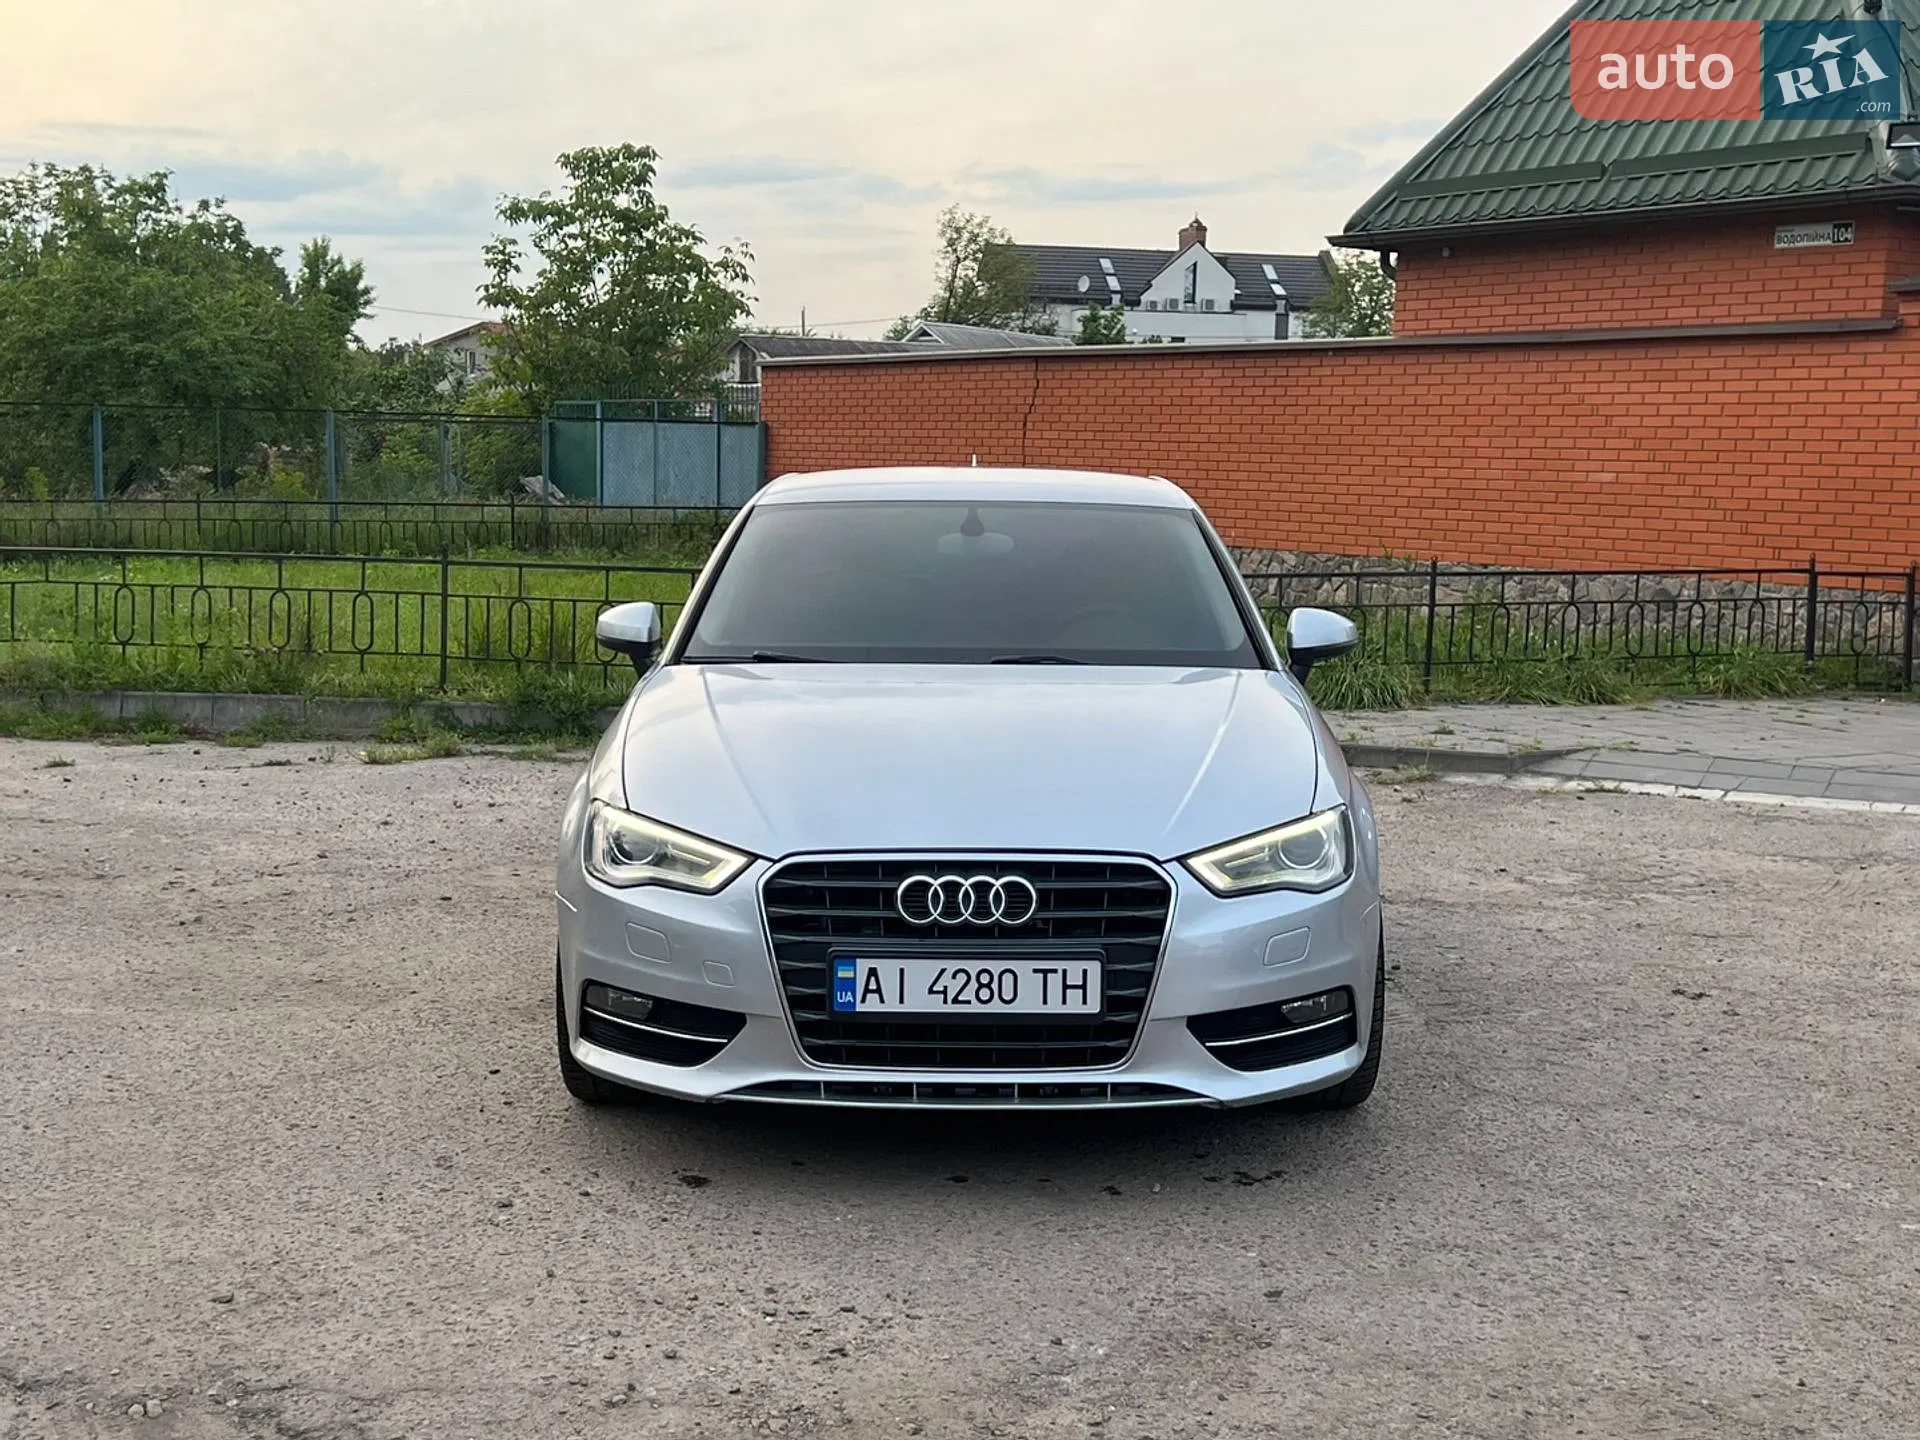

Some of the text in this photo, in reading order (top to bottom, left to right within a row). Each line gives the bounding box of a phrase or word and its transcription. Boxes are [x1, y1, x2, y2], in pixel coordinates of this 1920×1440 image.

[1833, 227, 1852, 242] 104
[927, 967, 1019, 1005] 4280
[1032, 967, 1089, 1005] TH
[837, 991, 854, 1003] UA
